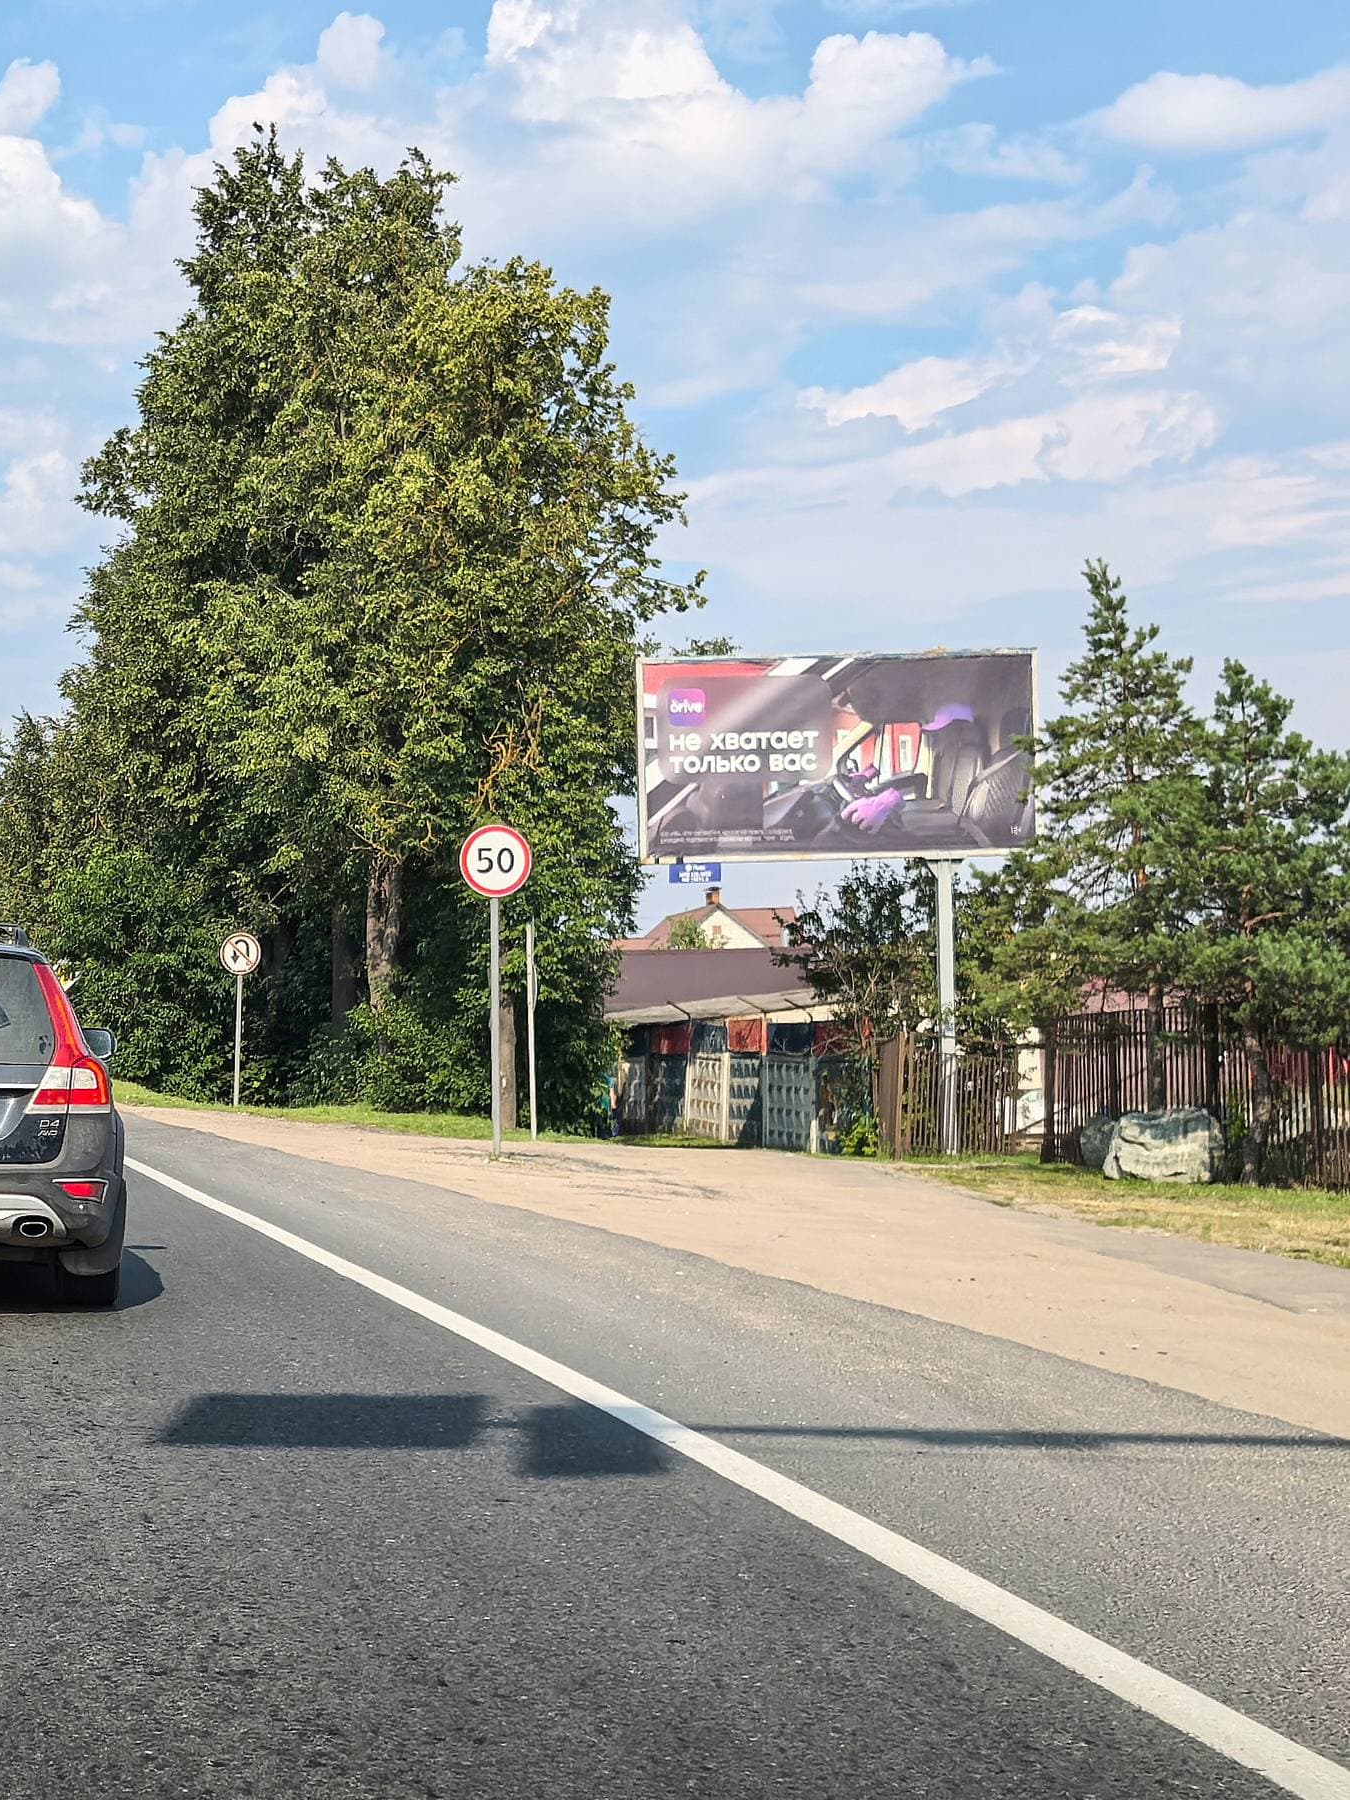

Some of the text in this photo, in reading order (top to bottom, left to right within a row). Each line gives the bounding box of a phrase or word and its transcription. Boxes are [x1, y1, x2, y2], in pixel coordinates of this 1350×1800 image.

[669, 731, 819, 751] не хватает
[669, 753, 817, 774] только вас
[477, 847, 515, 874] 50
[39, 1119, 60, 1128] D4
